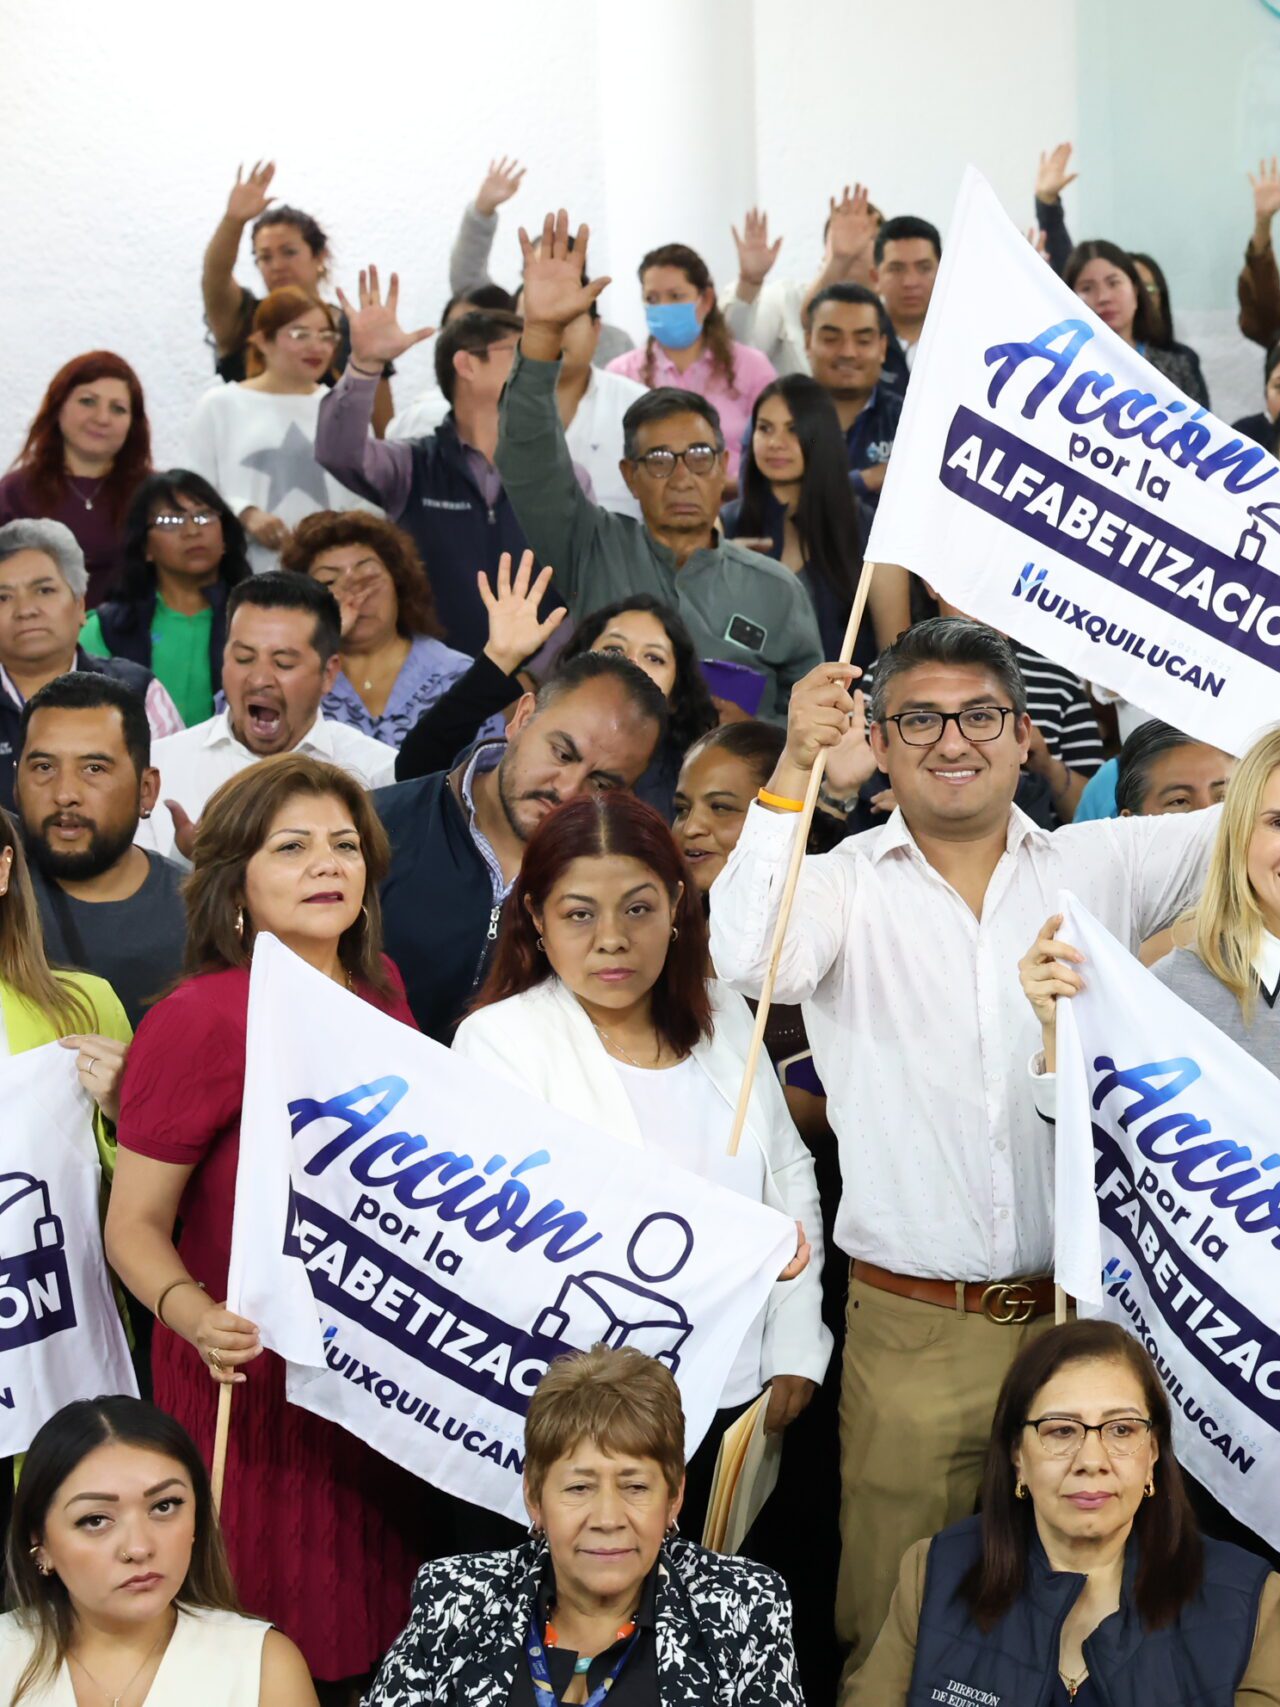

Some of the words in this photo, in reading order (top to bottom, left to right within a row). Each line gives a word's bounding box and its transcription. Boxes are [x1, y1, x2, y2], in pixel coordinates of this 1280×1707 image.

[984, 319, 1280, 495] Acción
[1069, 432, 1130, 478] por
[1136, 459, 1171, 502] la
[1011, 562, 1227, 698] HUIXQUILUCAN
[287, 1075, 604, 1263] Acción
[350, 1193, 420, 1245] por
[422, 1231, 464, 1276] la
[1136, 1166, 1192, 1225] por
[1189, 1215, 1229, 1263] la
[292, 1215, 550, 1397] FABETIZAC
[470, 1413, 523, 1443] 2025-20
[931, 1689, 949, 1703] DE
[946, 1679, 1001, 1706] DIRECCIÓN
